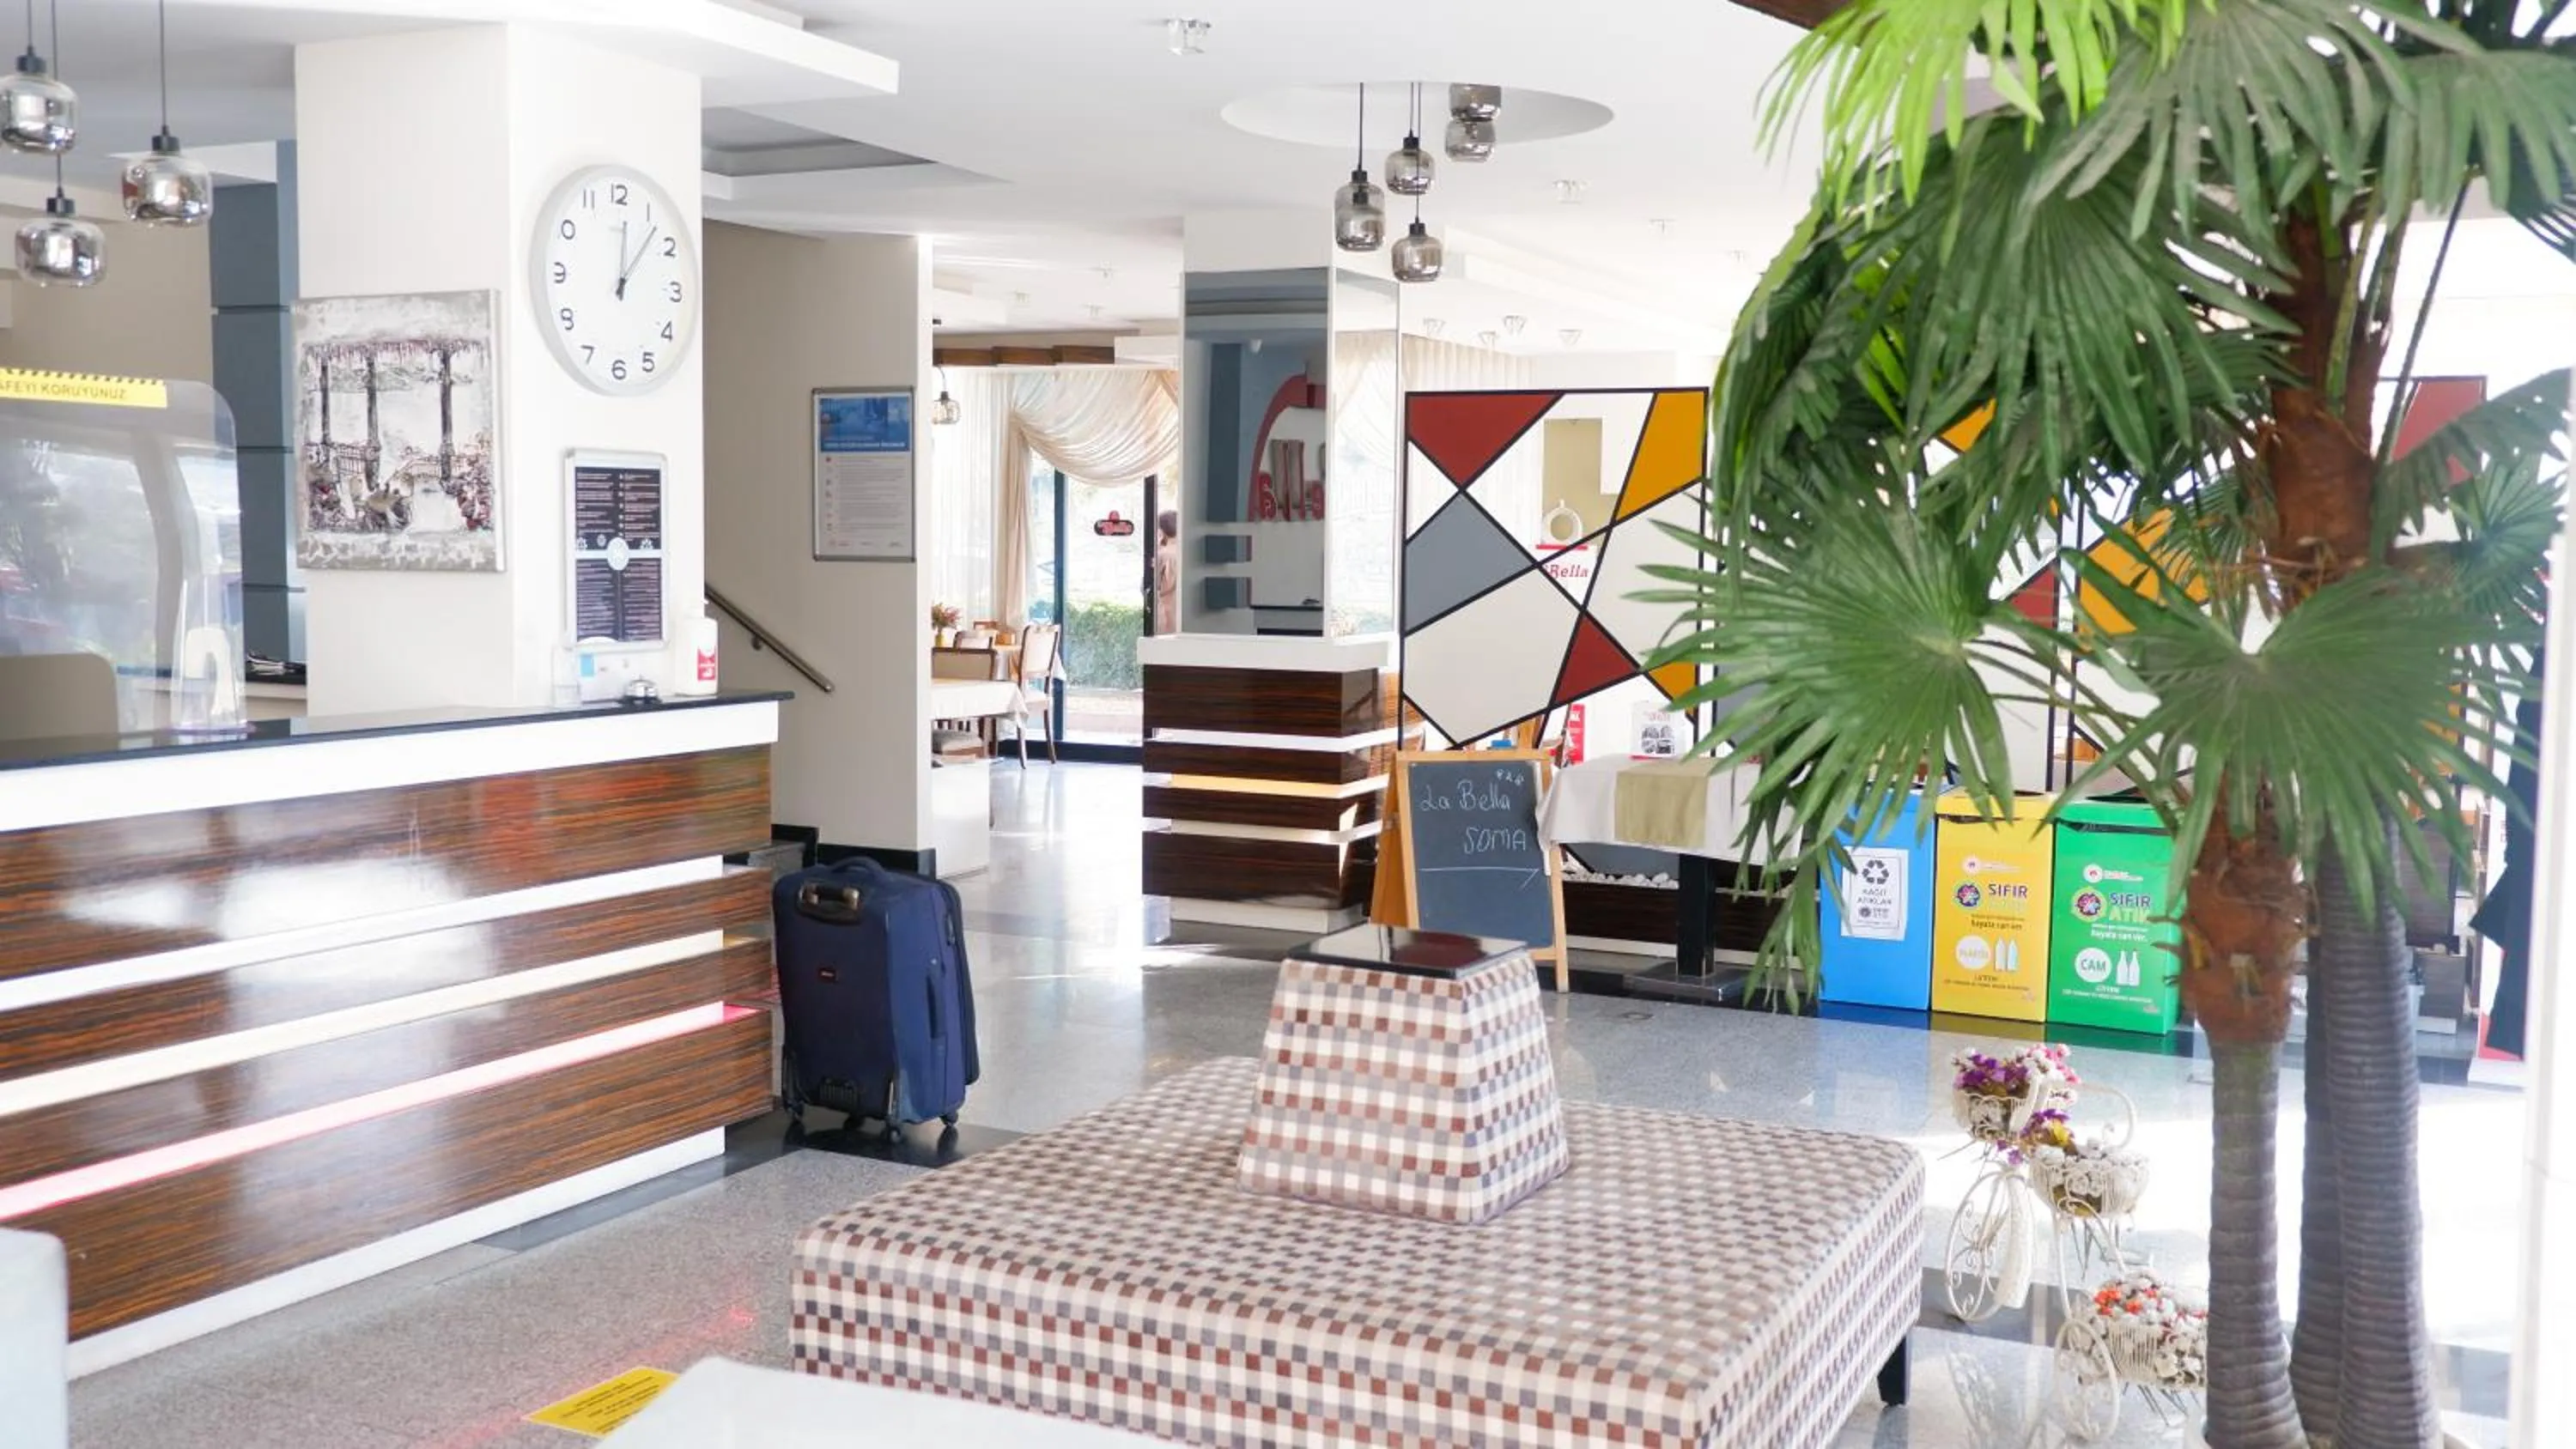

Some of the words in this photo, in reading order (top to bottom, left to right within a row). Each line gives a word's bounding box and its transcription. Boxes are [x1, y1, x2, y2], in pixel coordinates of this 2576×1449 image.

[582, 188, 595, 209] 11
[611, 183, 629, 205] 12
[663, 236, 677, 258] 2
[553, 261, 567, 283] 9
[669, 281, 683, 302] 3
[560, 306, 574, 330] 8
[660, 320, 673, 343] 4
[580, 344, 595, 366] 7
[641, 351, 655, 373] 5
[611, 359, 628, 380] 6
[1419, 785, 1451, 811] La
[1456, 779, 1511, 811] Bella
[1463, 826, 1527, 854] SOMA
[1988, 883, 2028, 899] SIFIR
[2110, 892, 2151, 907] SIFIR
[2081, 958, 2107, 973] CAM
